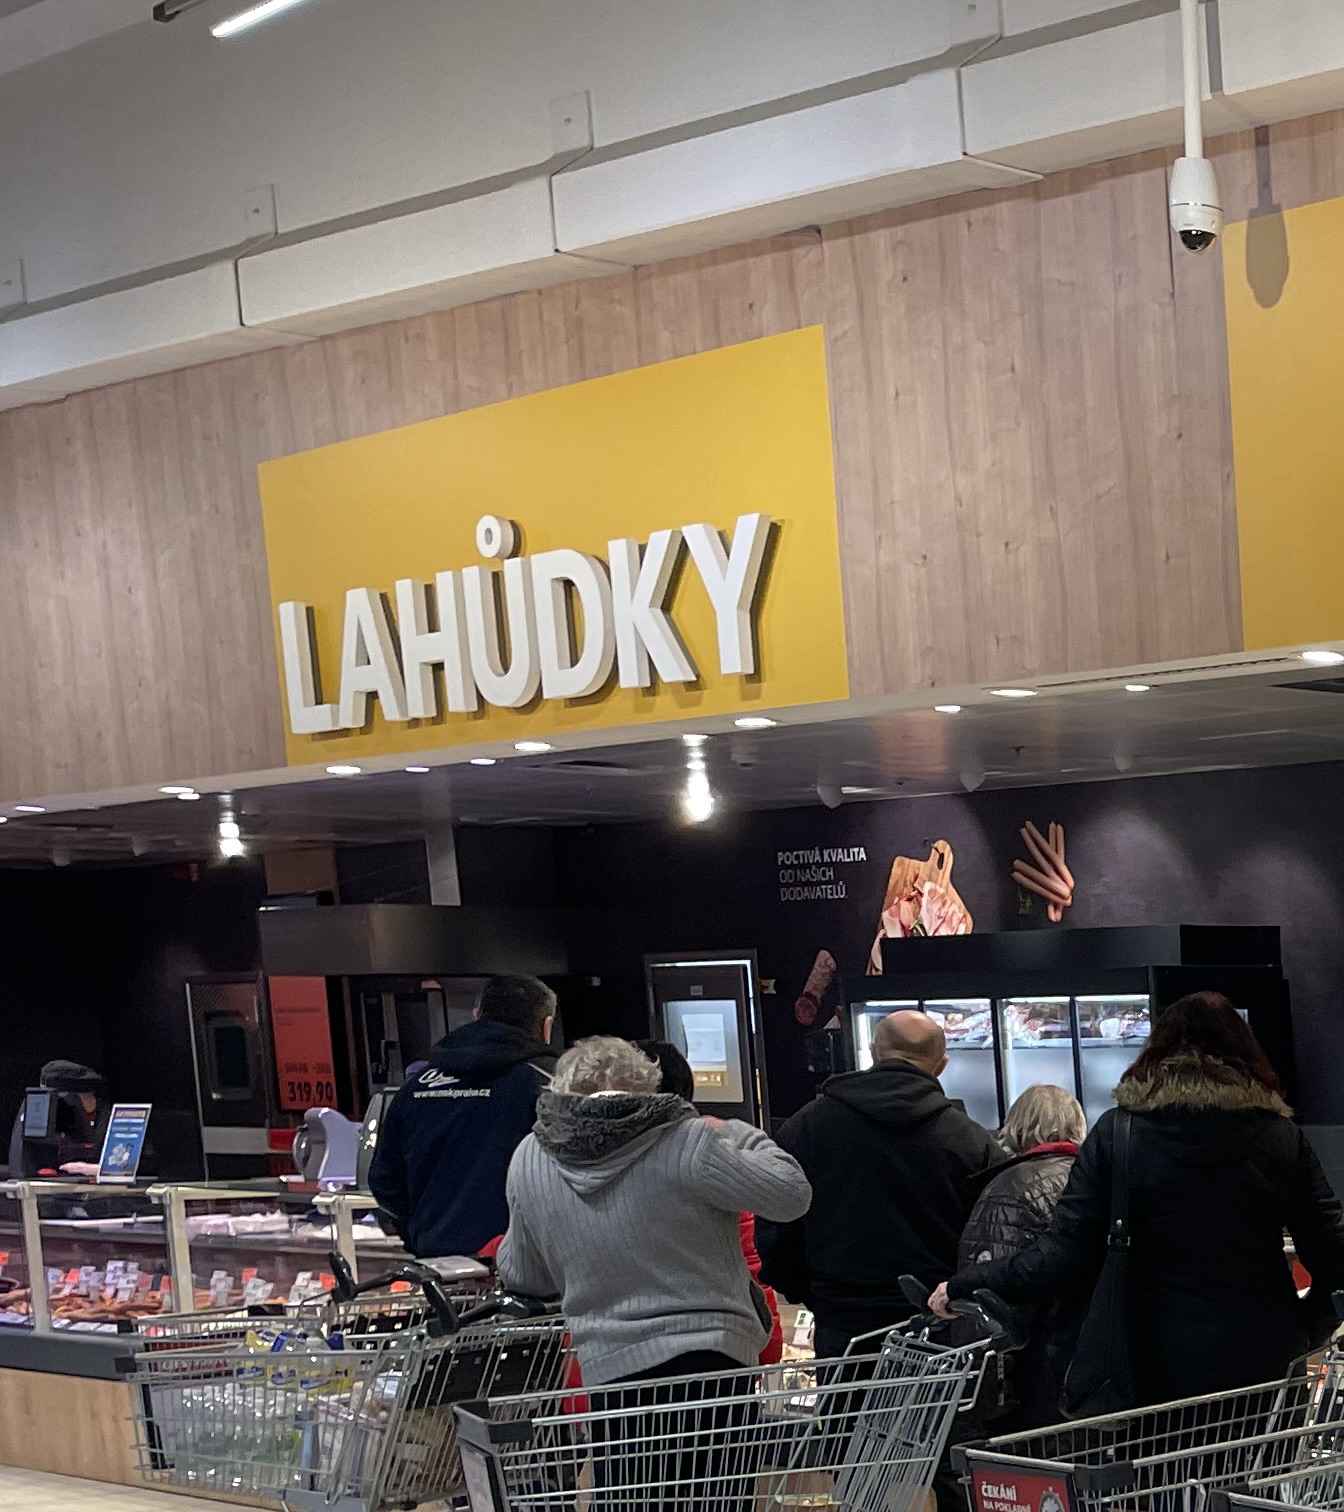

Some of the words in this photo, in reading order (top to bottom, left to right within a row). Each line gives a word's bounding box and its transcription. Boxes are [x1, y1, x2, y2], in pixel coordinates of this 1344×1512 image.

[278, 512, 772, 734] LAHŮDKY
[777, 847, 821, 866] POCTIVÁ
[823, 847, 867, 863] KVALITA
[779, 869, 795, 884] OD
[796, 865, 835, 882] NAŠICH
[981, 1480, 1017, 1502] ČEKÁNÍ
[983, 1500, 993, 1510] NA
